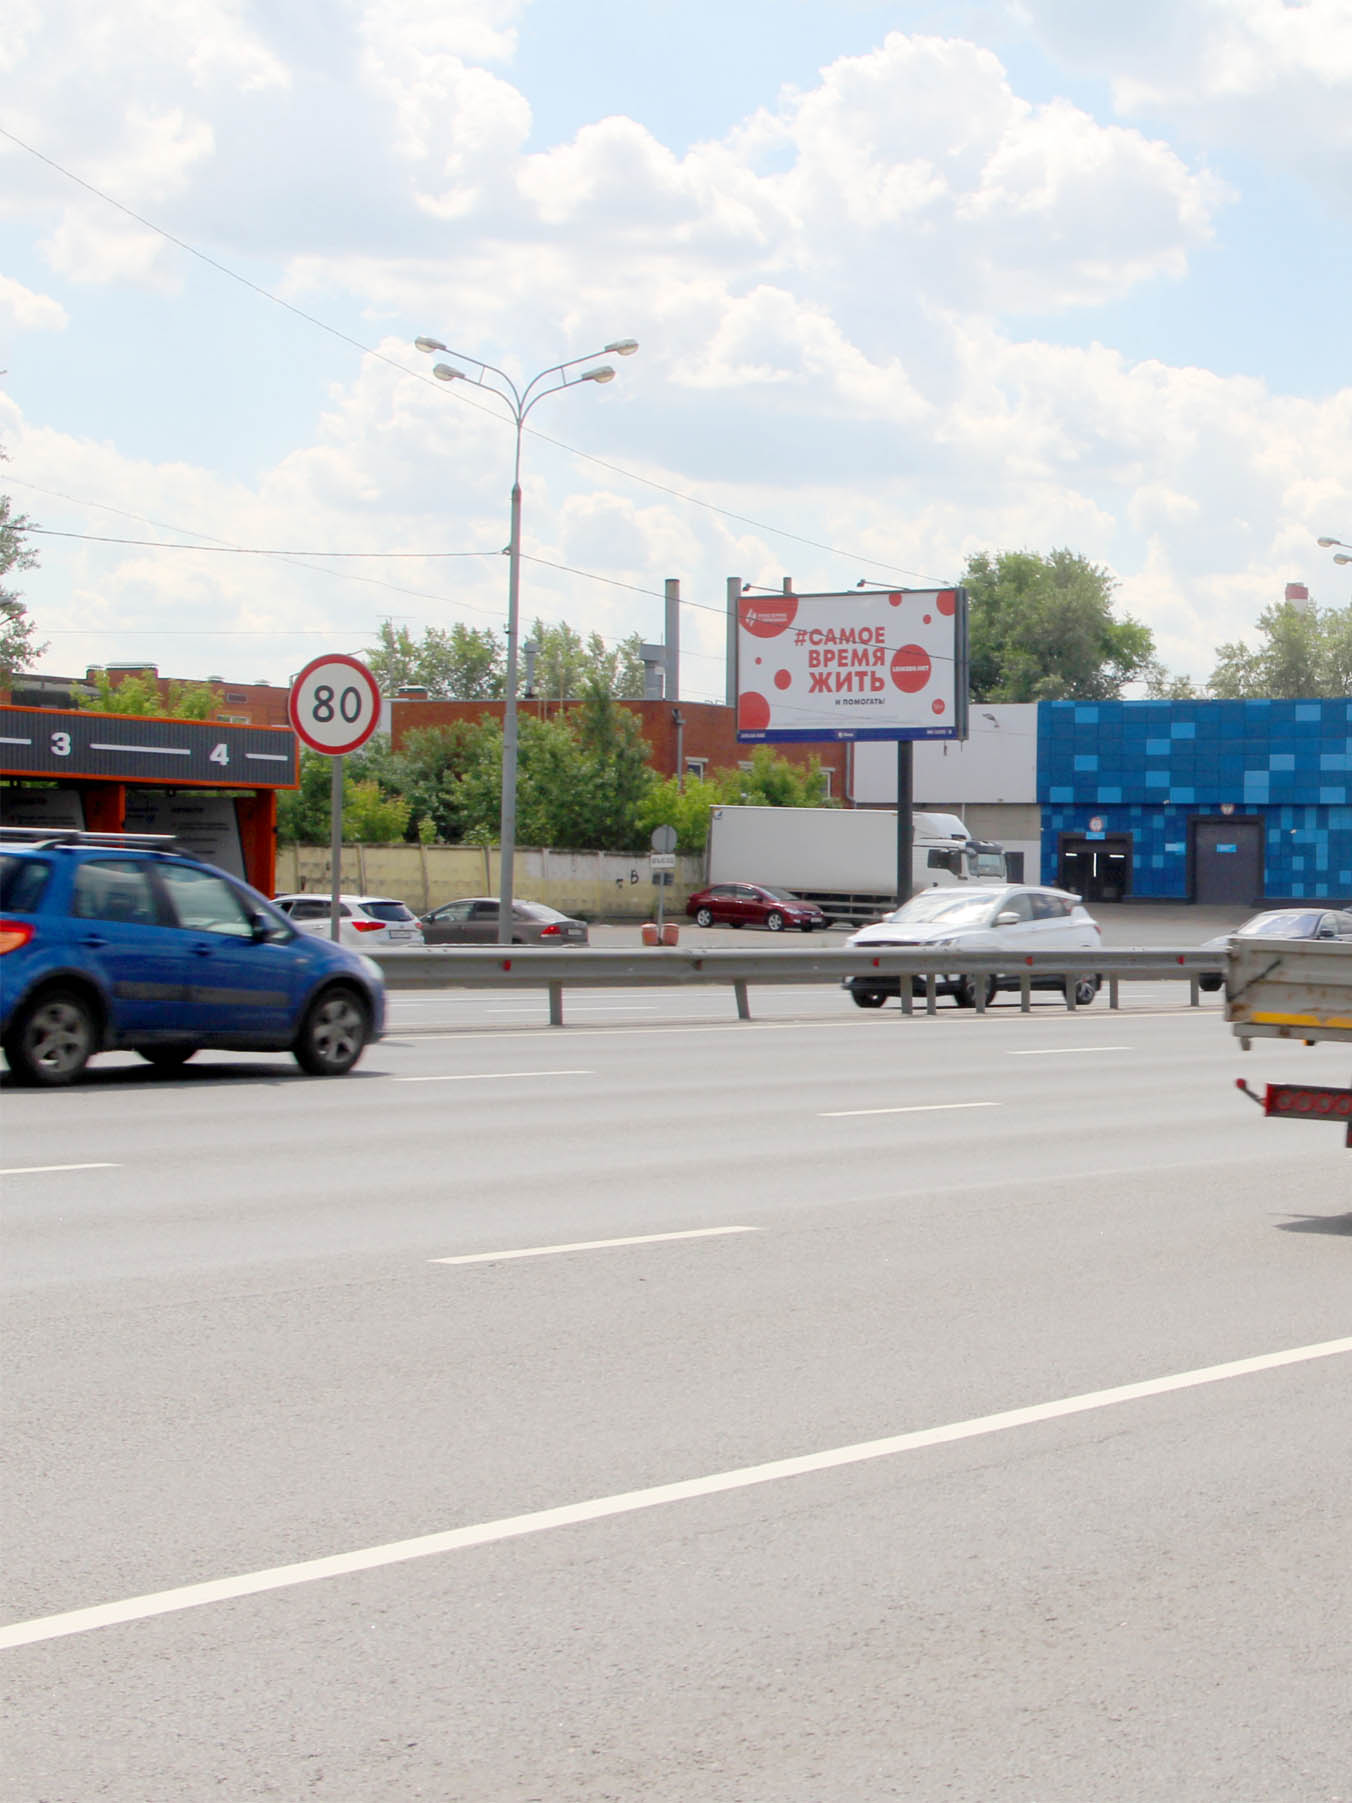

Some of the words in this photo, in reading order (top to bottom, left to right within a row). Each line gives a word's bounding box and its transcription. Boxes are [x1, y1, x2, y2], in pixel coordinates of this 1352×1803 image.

[794, 626, 885, 646] #САМОЕ
[808, 647, 885, 668] ВРЕМЯ
[808, 670, 885, 693] ЖИТЬ
[312, 685, 362, 724] 80
[50, 732, 72, 757] 3
[209, 743, 230, 766] 4
